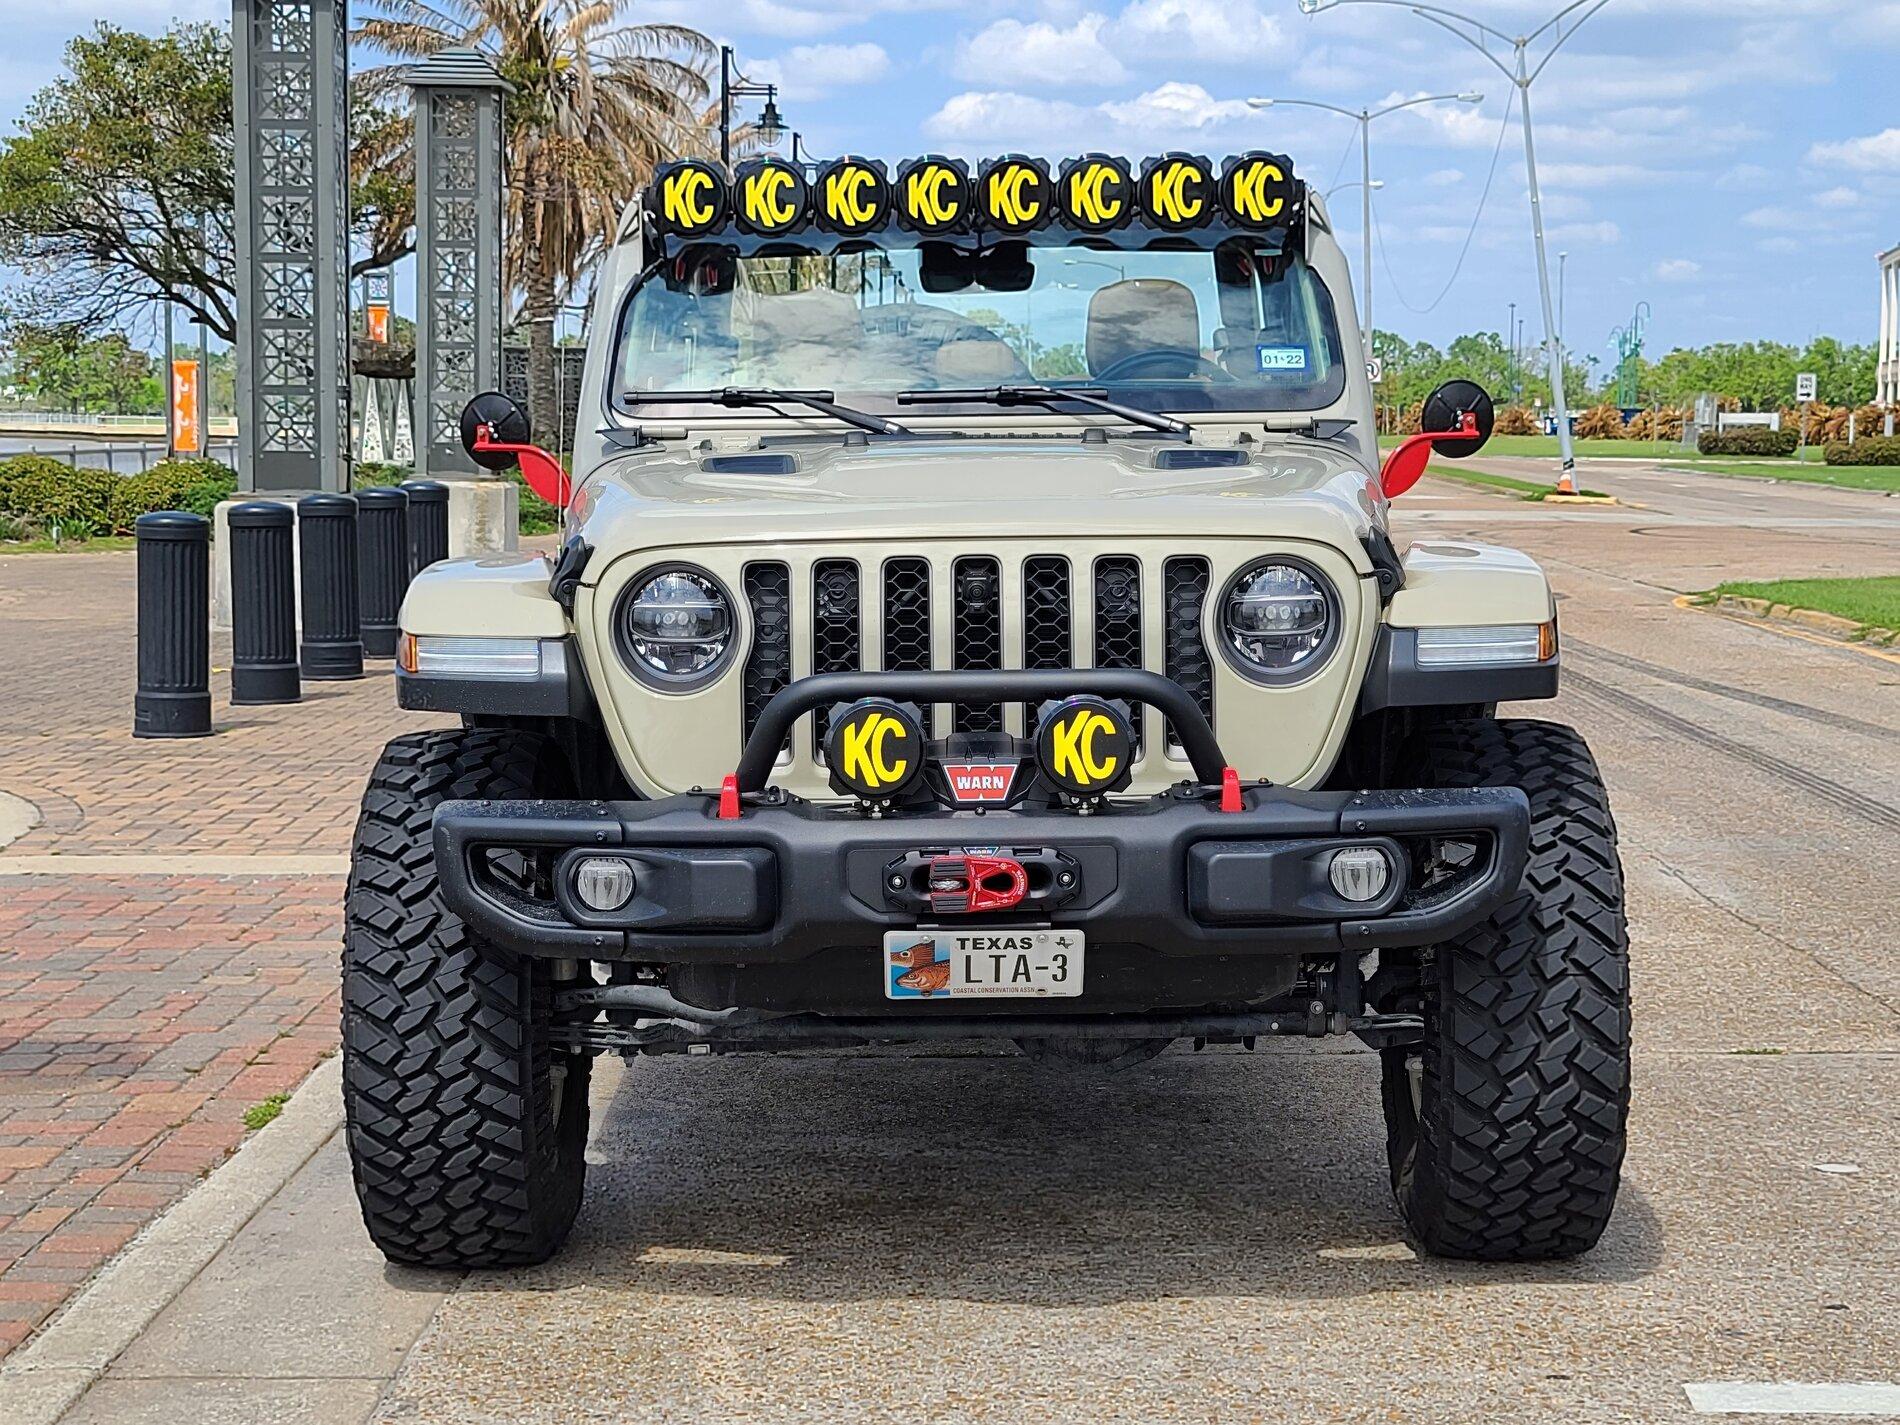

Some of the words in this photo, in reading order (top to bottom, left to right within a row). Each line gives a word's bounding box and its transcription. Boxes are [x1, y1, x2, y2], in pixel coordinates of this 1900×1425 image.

[666, 170, 713, 226] KC
[747, 168, 794, 225] KC
[828, 168, 875, 225] KC
[909, 167, 956, 224] KC
[990, 166, 1038, 224] KC
[1072, 165, 1121, 222] KC
[1153, 164, 1201, 221] KC
[1235, 163, 1282, 220] KC
[844, 713, 907, 788] KC
[1053, 710, 1117, 785] KC
[956, 775, 1004, 790] WARN
[1016, 869, 1025, 896] WARNING
[956, 937, 1033, 950] TEXAS
[964, 953, 1068, 984] LTA-3
